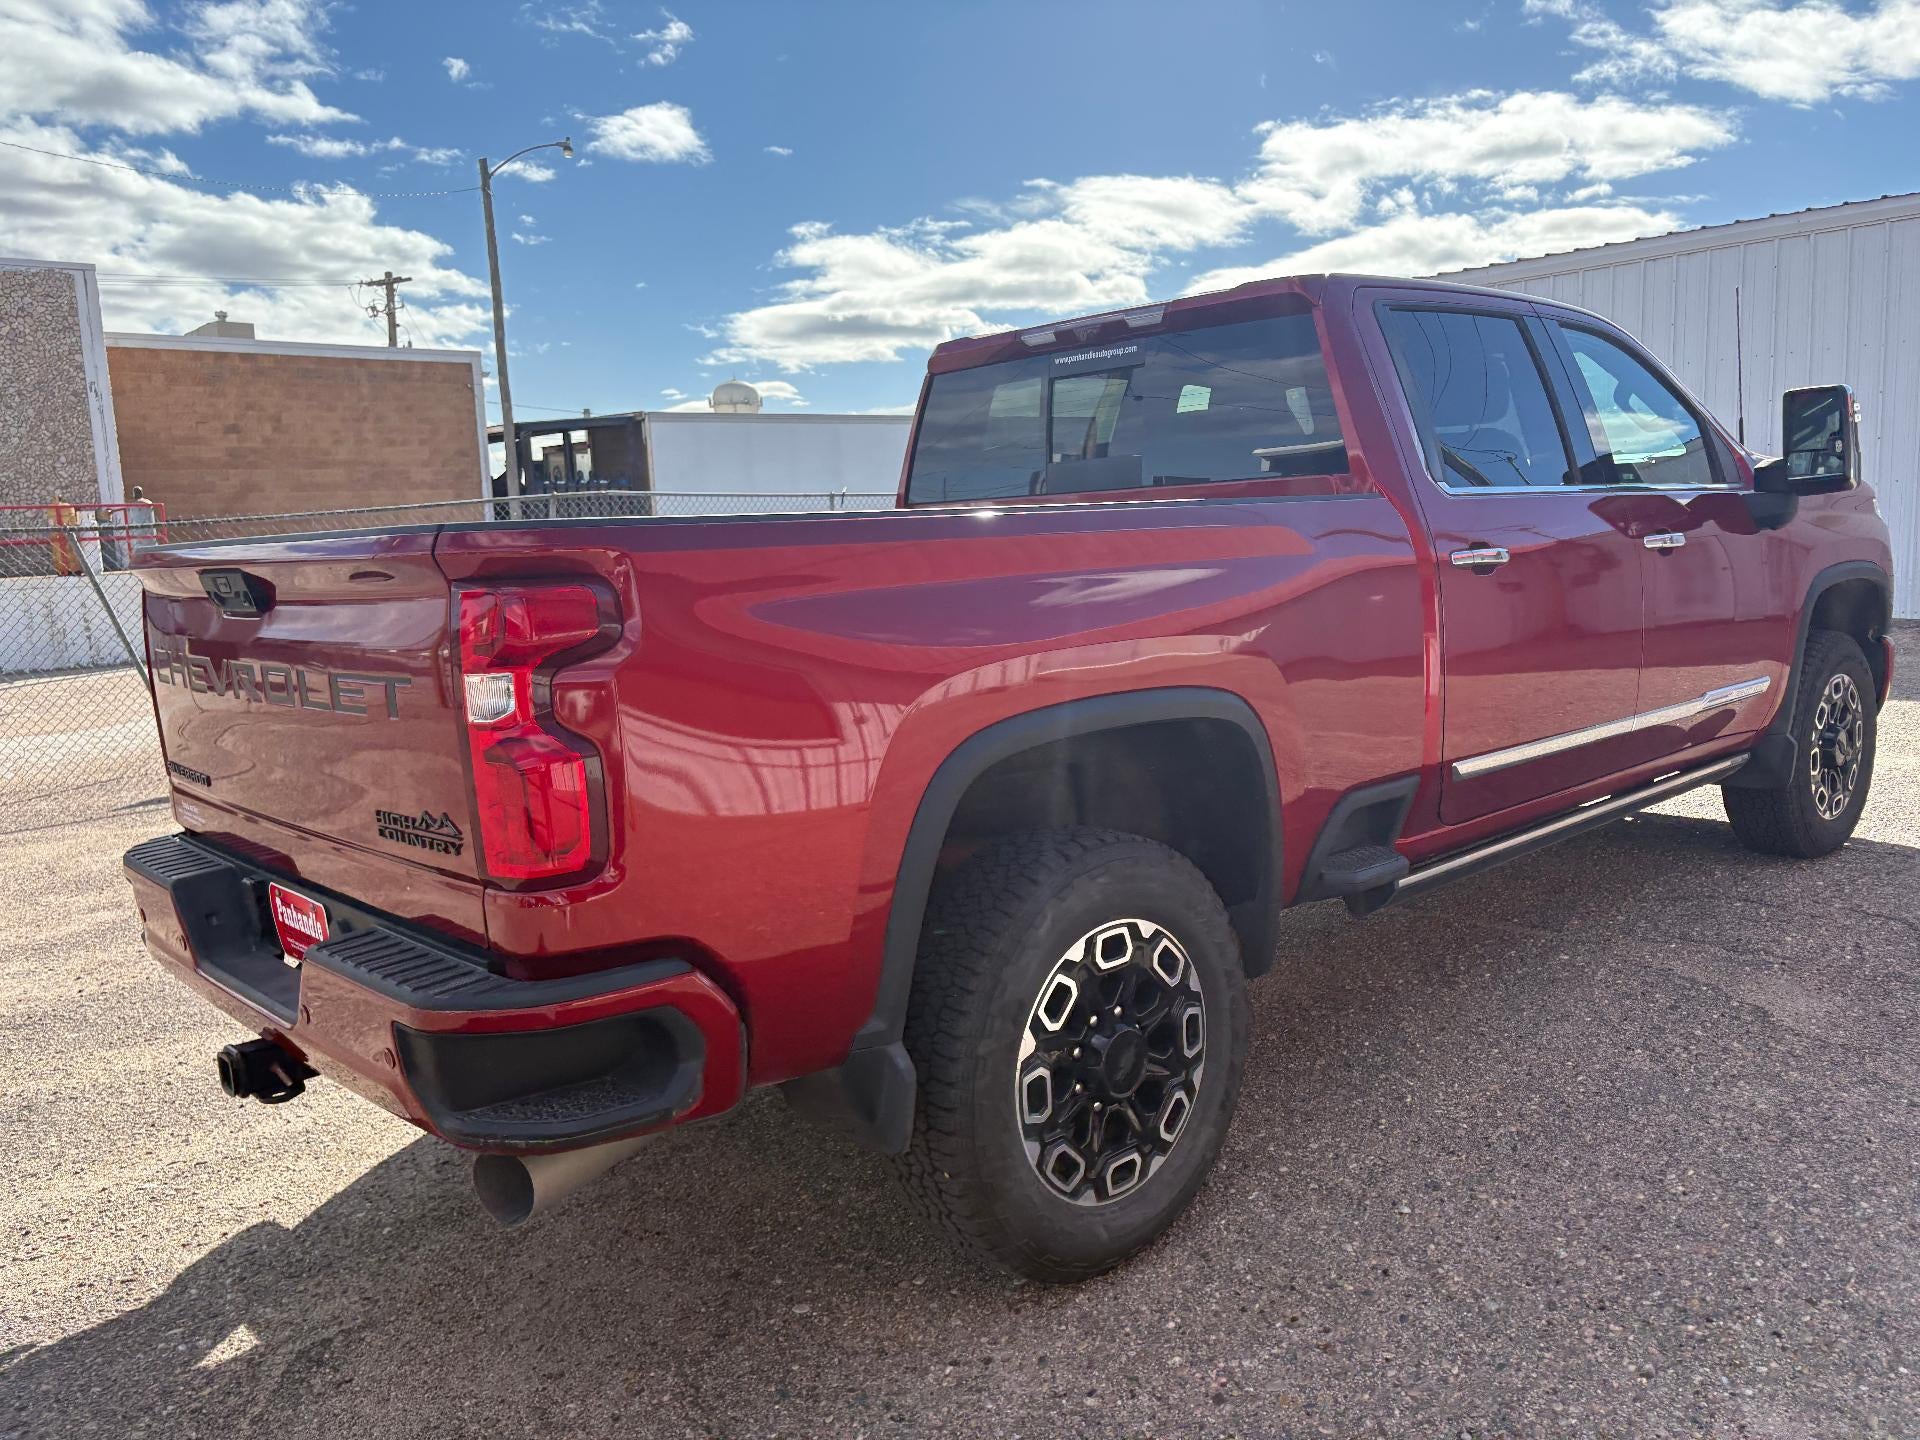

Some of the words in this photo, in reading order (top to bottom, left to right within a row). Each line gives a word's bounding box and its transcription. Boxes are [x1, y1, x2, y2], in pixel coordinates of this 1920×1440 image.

[1054, 345, 1138, 365] www.panhandleautogroup.com
[154, 647, 412, 720] CHEVROLET
[376, 810, 416, 831] HIGH
[378, 828, 464, 856] COUNTRY
[275, 896, 324, 942] Panhandle
